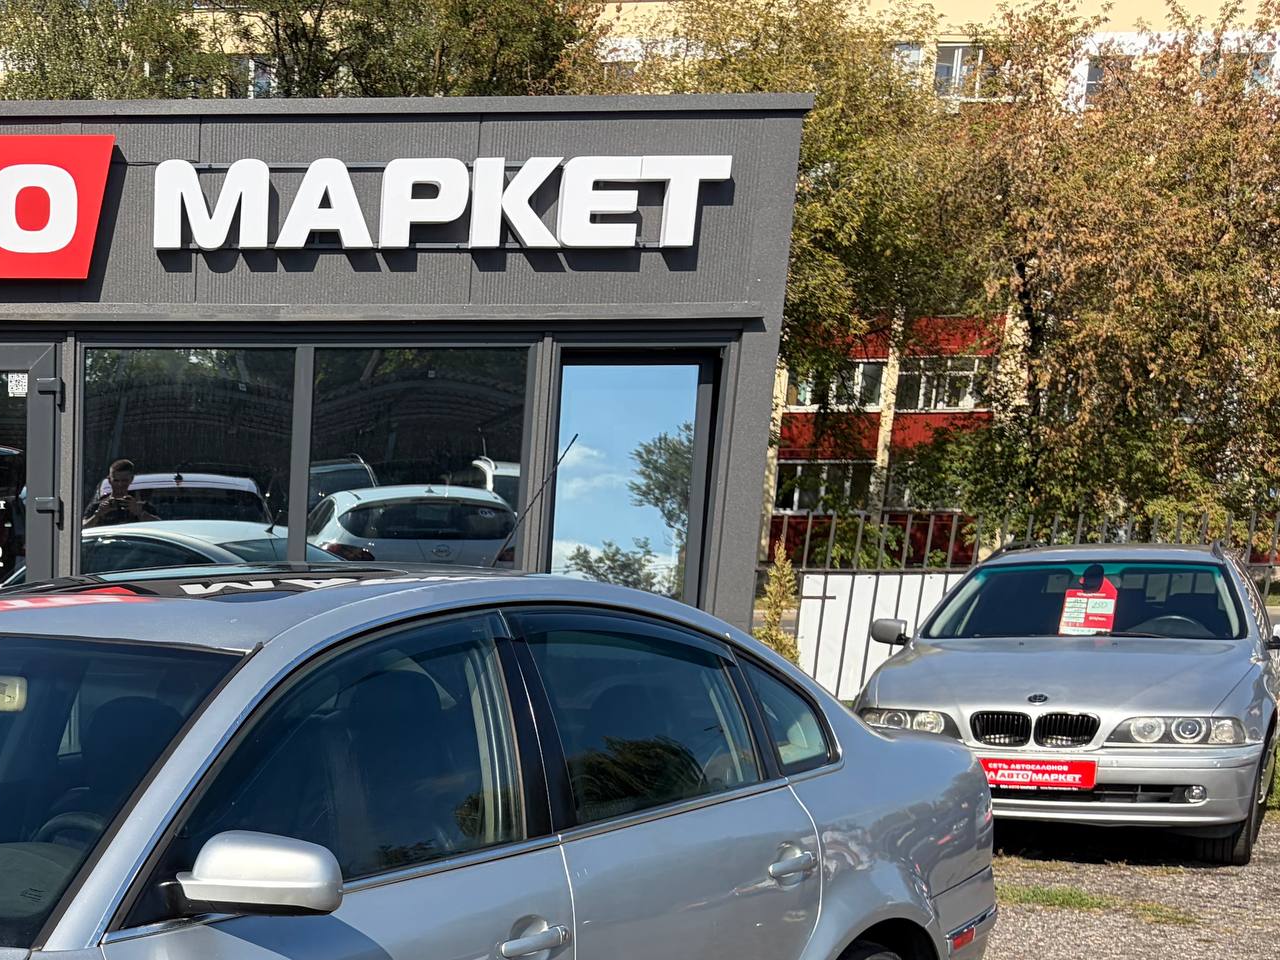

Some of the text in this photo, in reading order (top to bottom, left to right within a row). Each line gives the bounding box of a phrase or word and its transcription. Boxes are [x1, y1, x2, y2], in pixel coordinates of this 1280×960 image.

[153, 155, 733, 252] МАРКЕТ
[999, 773, 1030, 781] АВТО
[1031, 773, 1082, 783] МАРКЕТ
